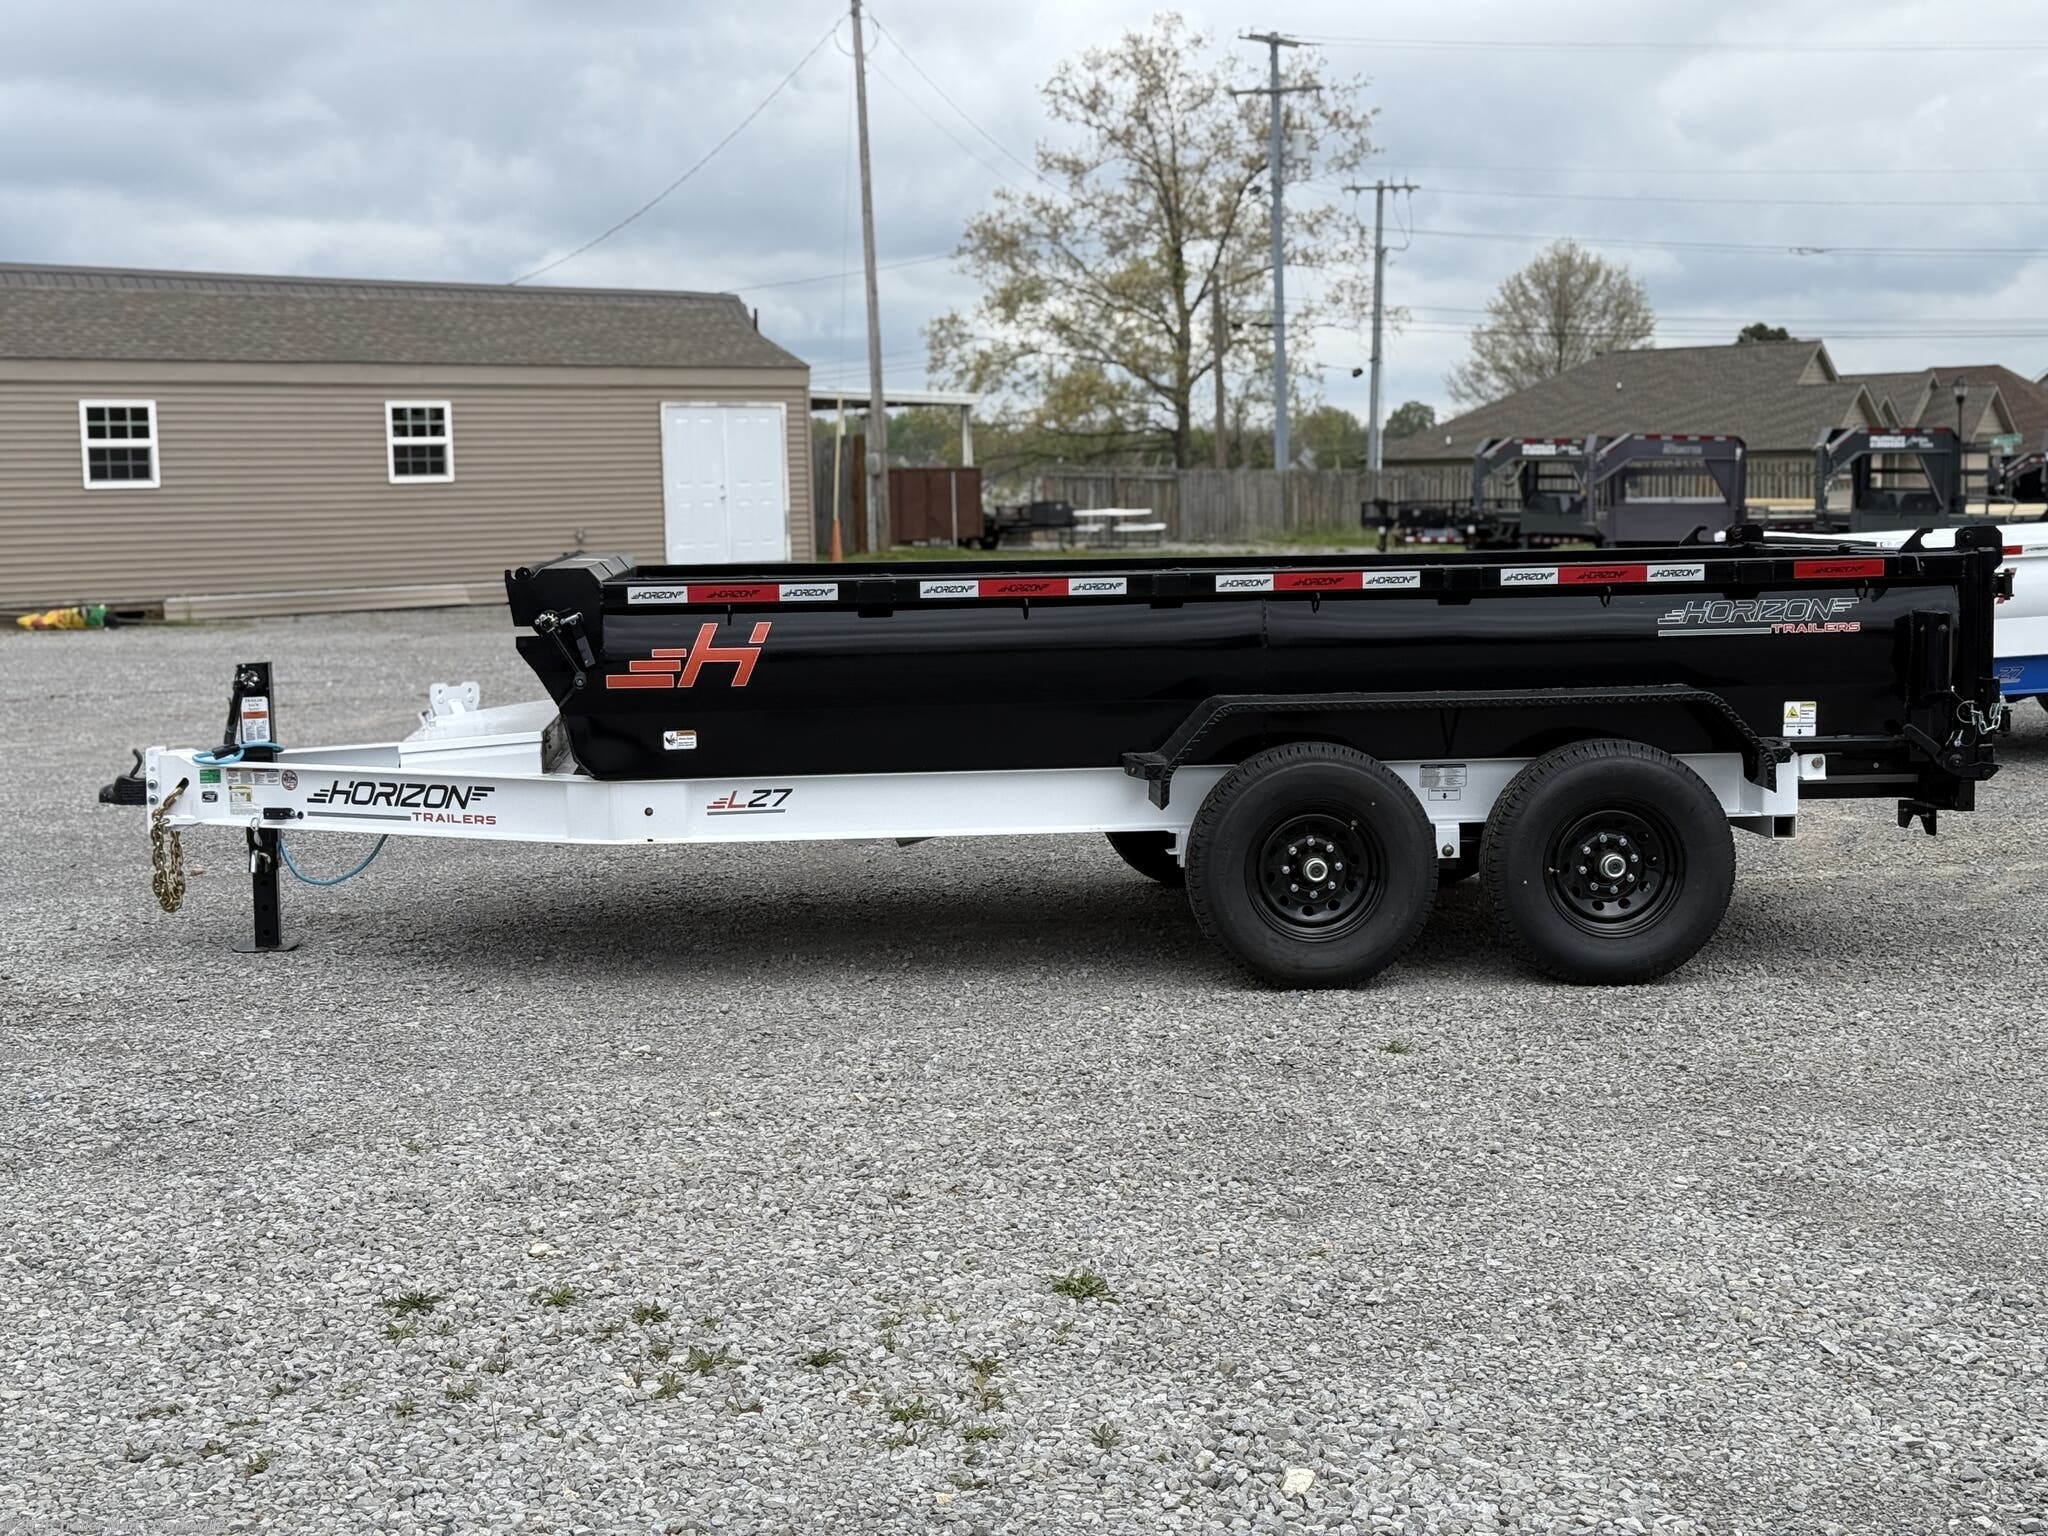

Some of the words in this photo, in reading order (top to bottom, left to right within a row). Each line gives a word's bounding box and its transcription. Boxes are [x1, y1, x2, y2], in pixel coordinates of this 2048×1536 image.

[1225, 579, 1265, 588] HORIZON
[1298, 577, 1338, 586] HORIZON
[1371, 575, 1411, 585] HORIZON
[1510, 572, 1550, 582] HORIZON
[1582, 571, 1621, 580] HORIZON
[1656, 568, 1696, 578] HORIZON
[929, 585, 969, 593] HORIZON
[1002, 584, 1043, 592] HORIZON
[1077, 582, 1118, 591] HORIZON
[637, 591, 679, 600] HORIZON
[712, 590, 754, 598] HORIZON
[788, 589, 829, 597] HORIZON
[1681, 598, 1835, 624] HORIZON
[1771, 622, 1860, 634] TRAILERS
[327, 780, 473, 810] HORIZON
[726, 788, 793, 808] L27
[412, 812, 497, 825] TRAILERS
